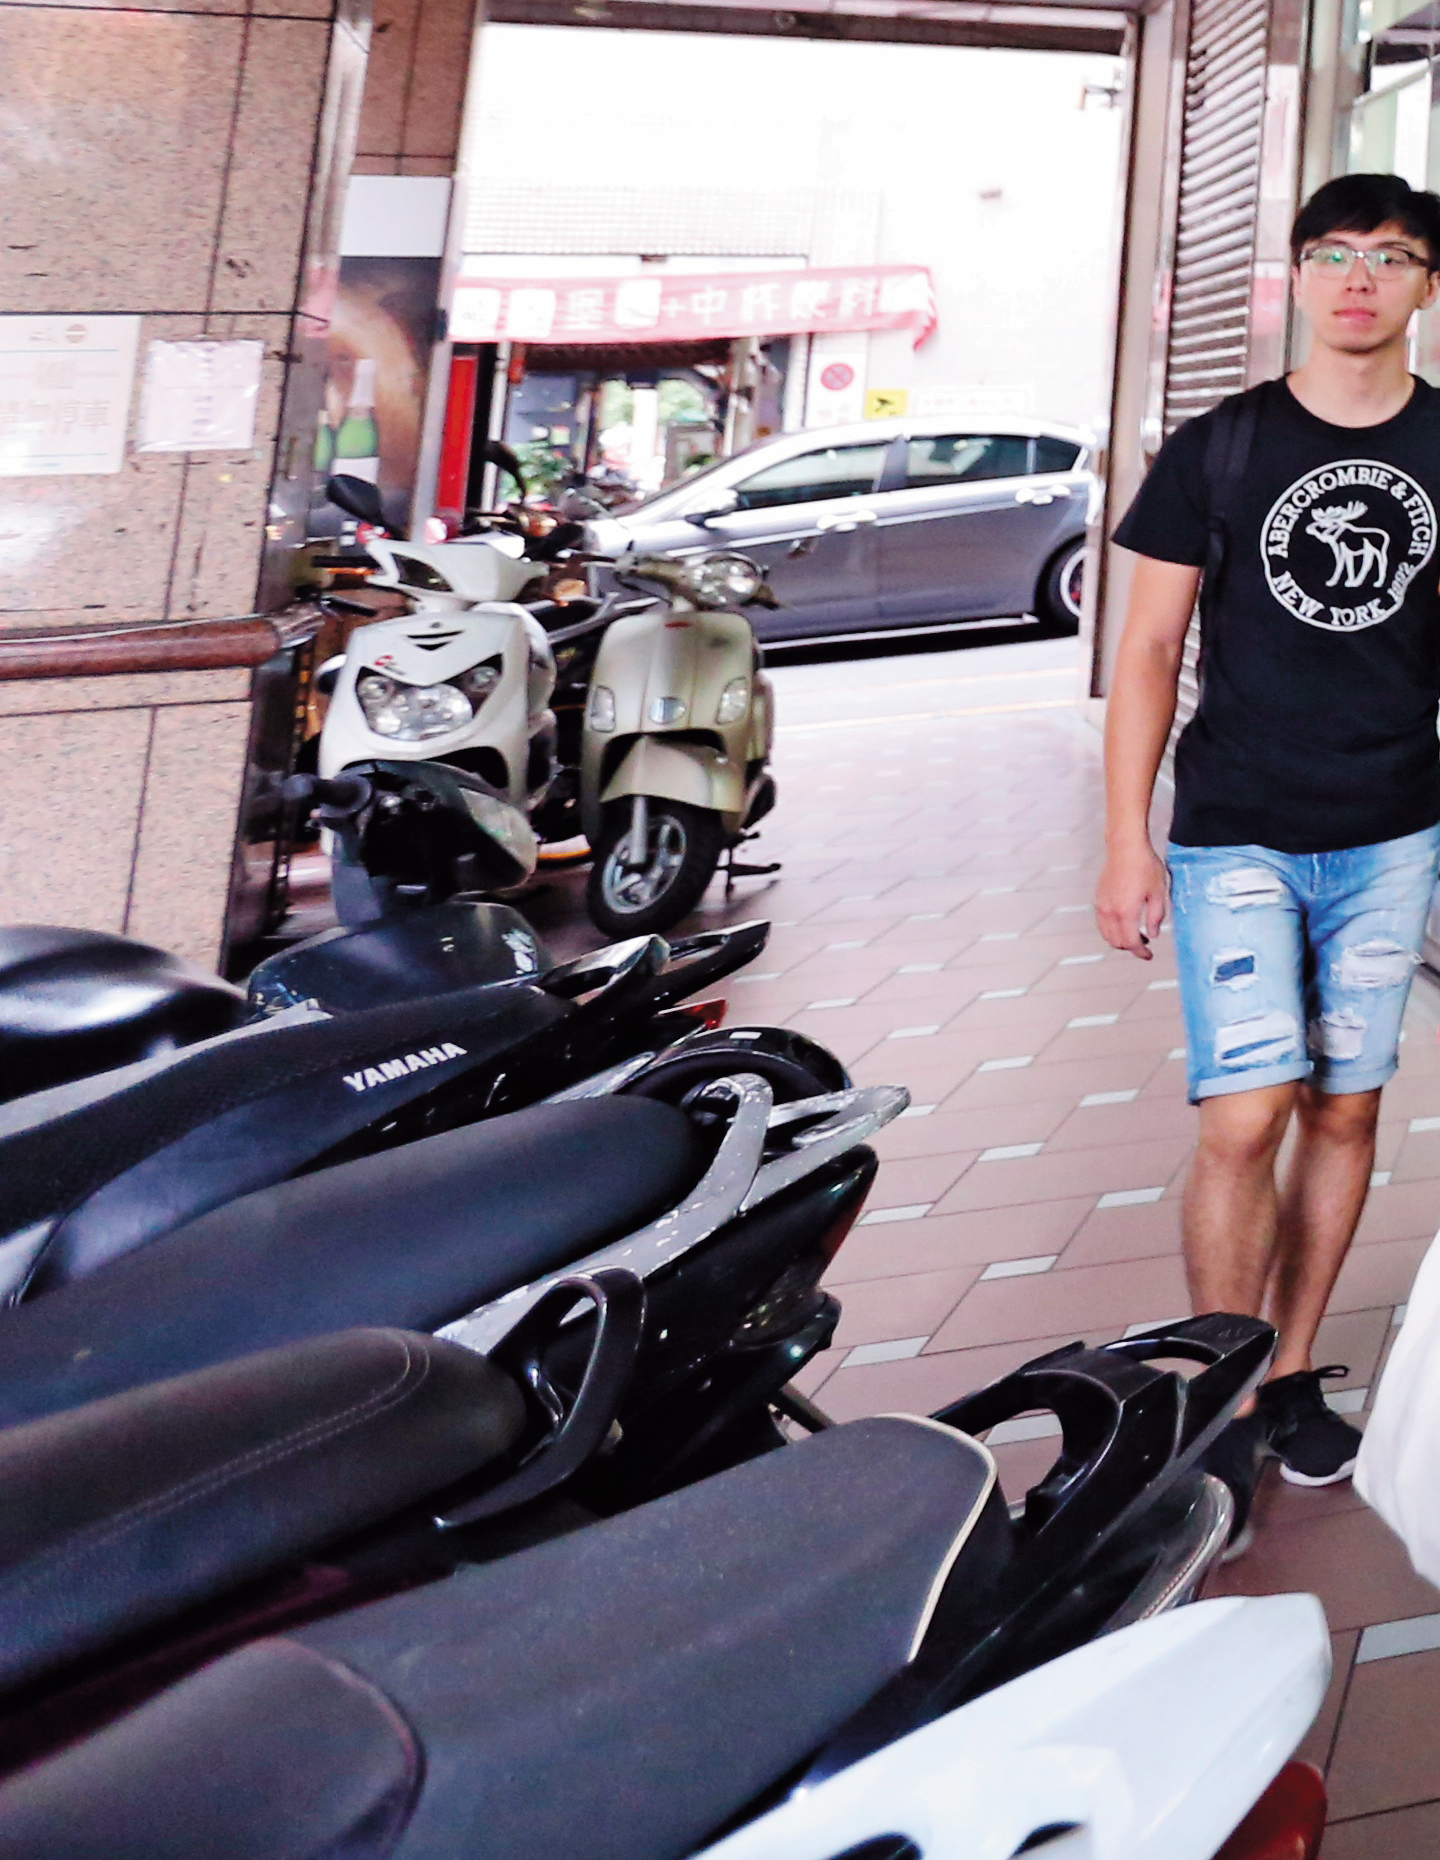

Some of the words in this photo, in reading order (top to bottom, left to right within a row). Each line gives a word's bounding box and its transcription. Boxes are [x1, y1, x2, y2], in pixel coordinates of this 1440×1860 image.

[1268, 466, 1393, 558] ABERCROMBIE
[1390, 481, 1408, 501] &
[1403, 493, 1432, 556] FITCH
[1272, 570, 1325, 618] NEW
[1330, 597, 1389, 627] YORK
[342, 1042, 468, 1092] YAMAHA
